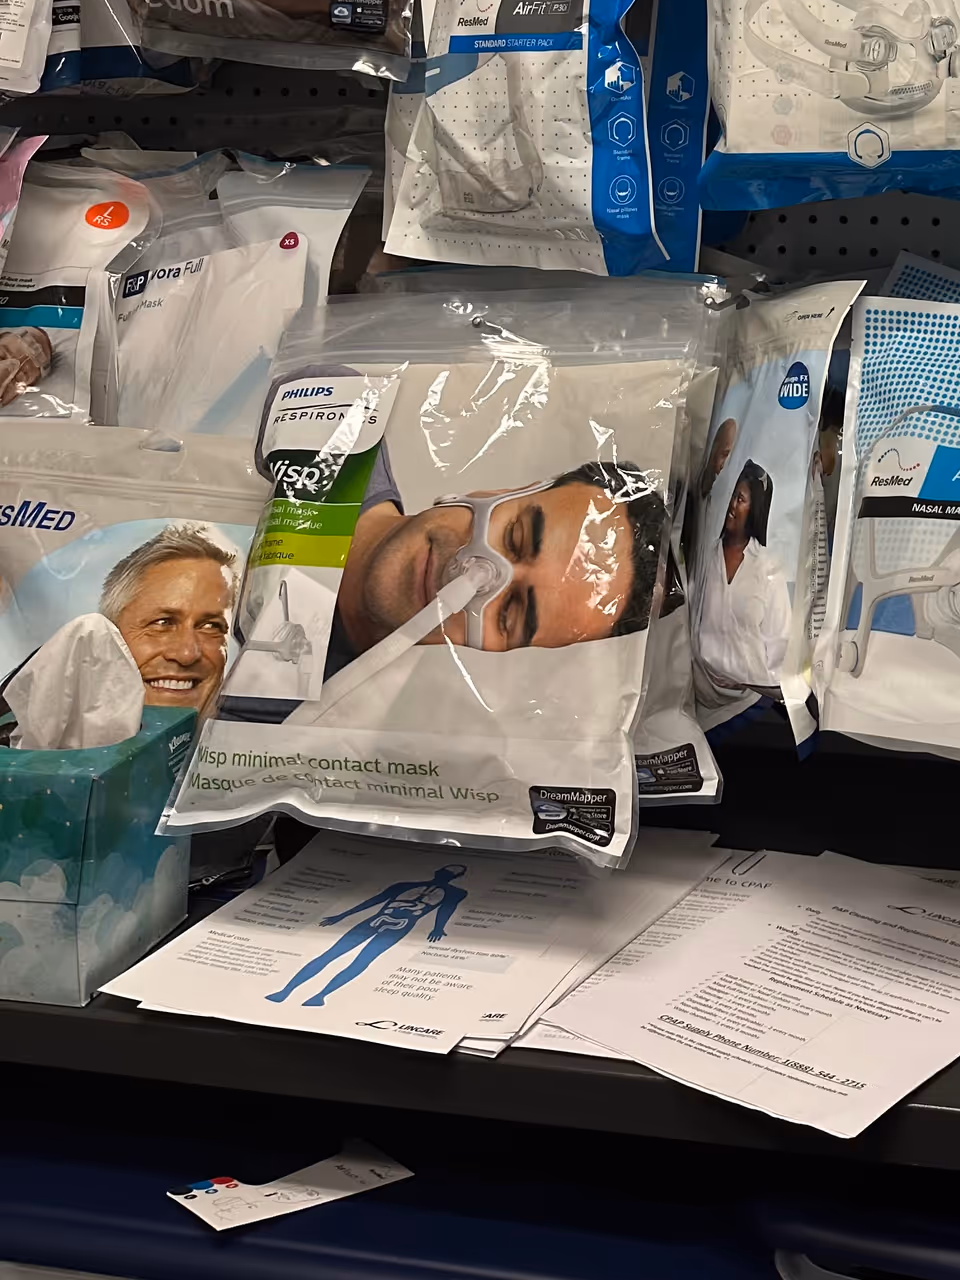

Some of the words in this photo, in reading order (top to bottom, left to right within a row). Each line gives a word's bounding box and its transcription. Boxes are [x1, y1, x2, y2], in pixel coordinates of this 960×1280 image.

[513, 2, 547, 15] AirFit
[457, 17, 488, 27] ResMed
[474, 39, 506, 48] STANDARD
[507, 39, 536, 47] STARTER
[537, 39, 554, 47] PACK
[102, 206, 115, 218] L
[93, 215, 111, 227] RS
[283, 237, 295, 246] XS
[126, 276, 144, 293] F&P
[183, 258, 204, 276] Full
[282, 386, 334, 402] PHILIPS
[780, 382, 809, 398] WIDE
[871, 475, 912, 488] ResMed
[287, 506, 317, 518] mask
[911, 504, 944, 515] NASAL
[232, 751, 303, 768] minimal
[309, 755, 381, 773] contact
[388, 761, 440, 777] mask
[190, 772, 256, 793] Masque
[263, 772, 288, 784] de
[294, 773, 362, 791] contact
[367, 780, 444, 799] minimal
[450, 786, 499, 803] Wisp
[540, 789, 607, 803] DreamMapper
[725, 878, 738, 887] to
[741, 880, 774, 890] CPAP
[776, 926, 799, 936] Weekly
[849, 911, 882, 925] Cleaning
[883, 920, 898, 928] and
[899, 924, 949, 944] Replacement
[208, 929, 234, 939] Medical
[396, 967, 422, 976] Many
[424, 970, 462, 981] patients
[389, 973, 409, 982] may
[411, 976, 427, 984] not
[443, 982, 473, 990] aware
[394, 981, 415, 990] their
[415, 985, 440, 993] poor
[374, 986, 399, 996] sleep
[769, 976, 813, 994] Replacement
[813, 991, 844, 1006] Schedule
[854, 1004, 890, 1020] Necessary
[398, 1024, 445, 1036] LINCARE
[659, 1014, 684, 1026] CPAP
[683, 1021, 711, 1037] Supply
[713, 1033, 742, 1048] Phone
[742, 1044, 781, 1062] Number:
